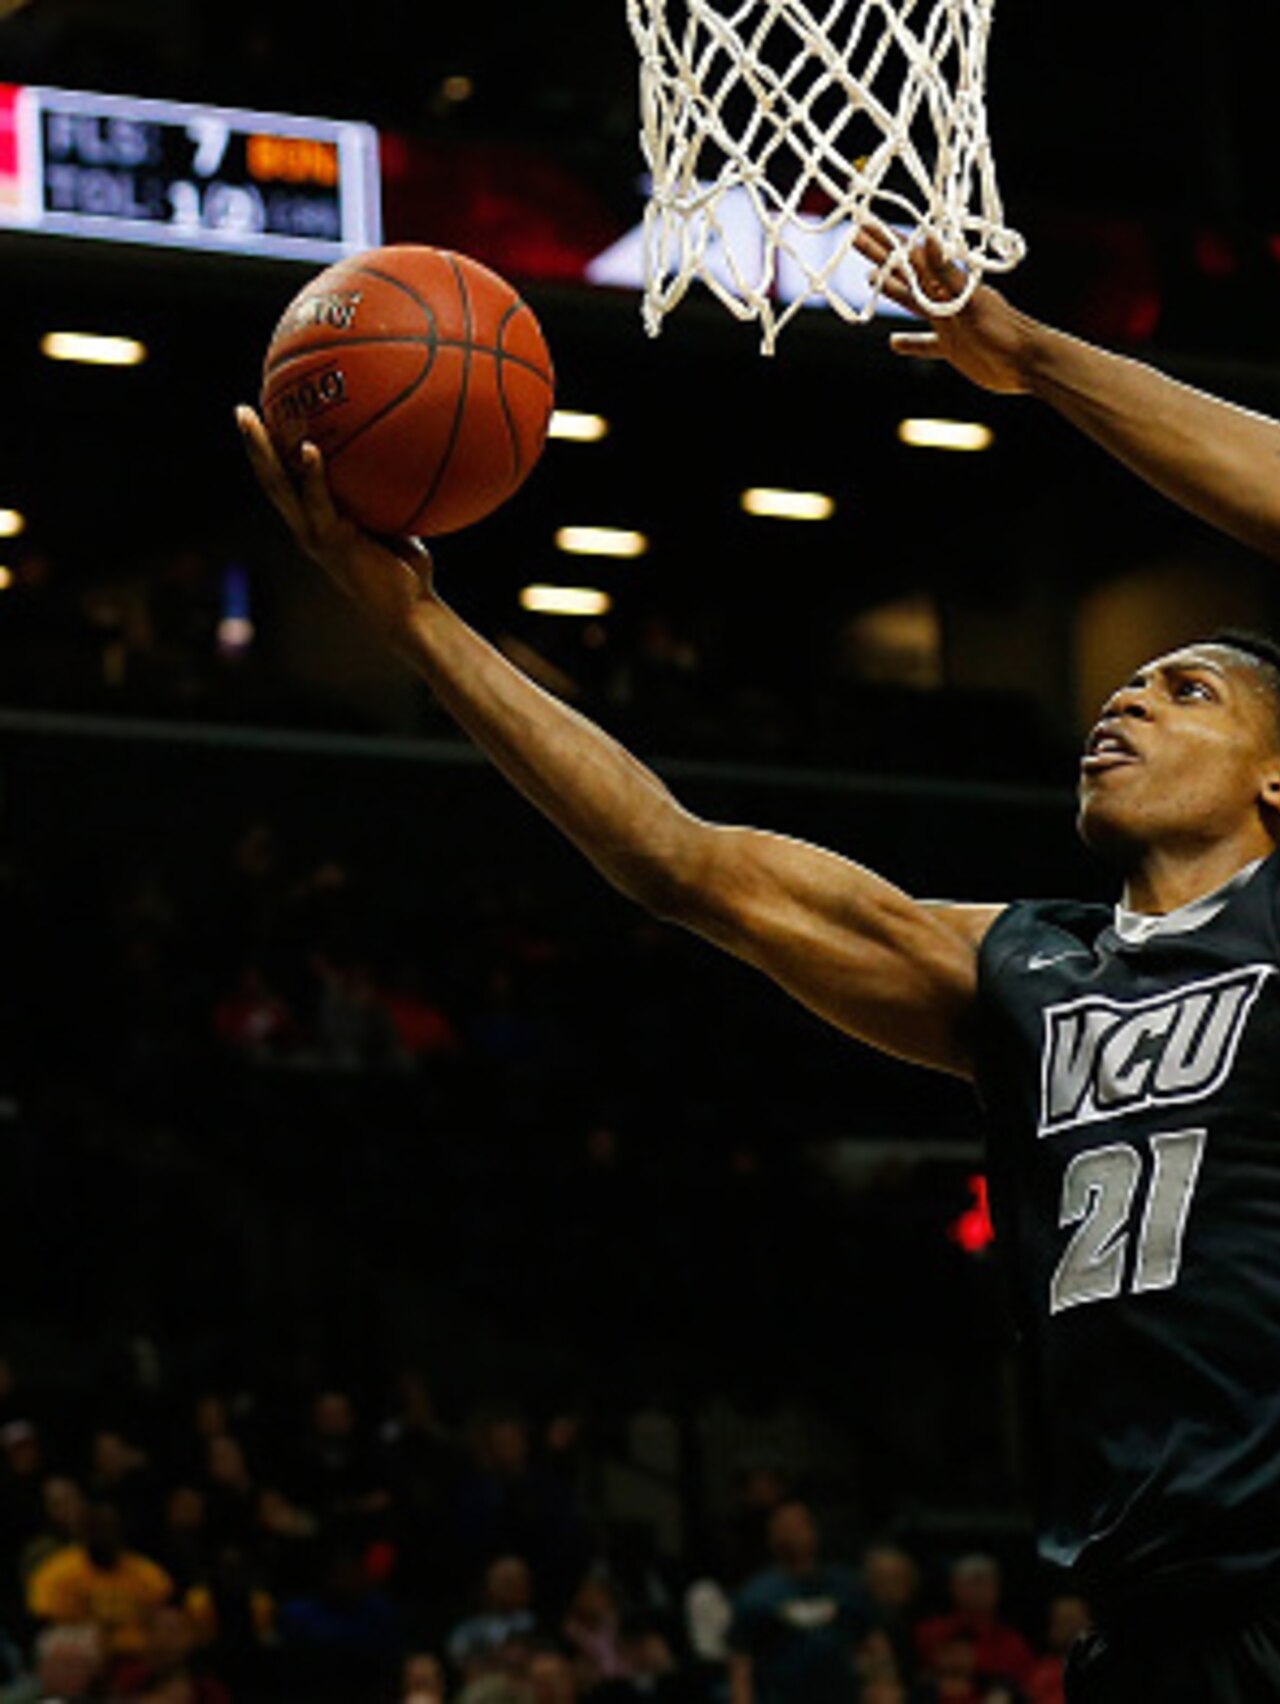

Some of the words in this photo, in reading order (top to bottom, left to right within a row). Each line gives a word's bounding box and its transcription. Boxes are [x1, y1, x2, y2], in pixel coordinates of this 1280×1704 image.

[186, 117, 228, 177] 7
[1039, 965, 1275, 1137] VCU
[1050, 1127, 1207, 1315] 21
